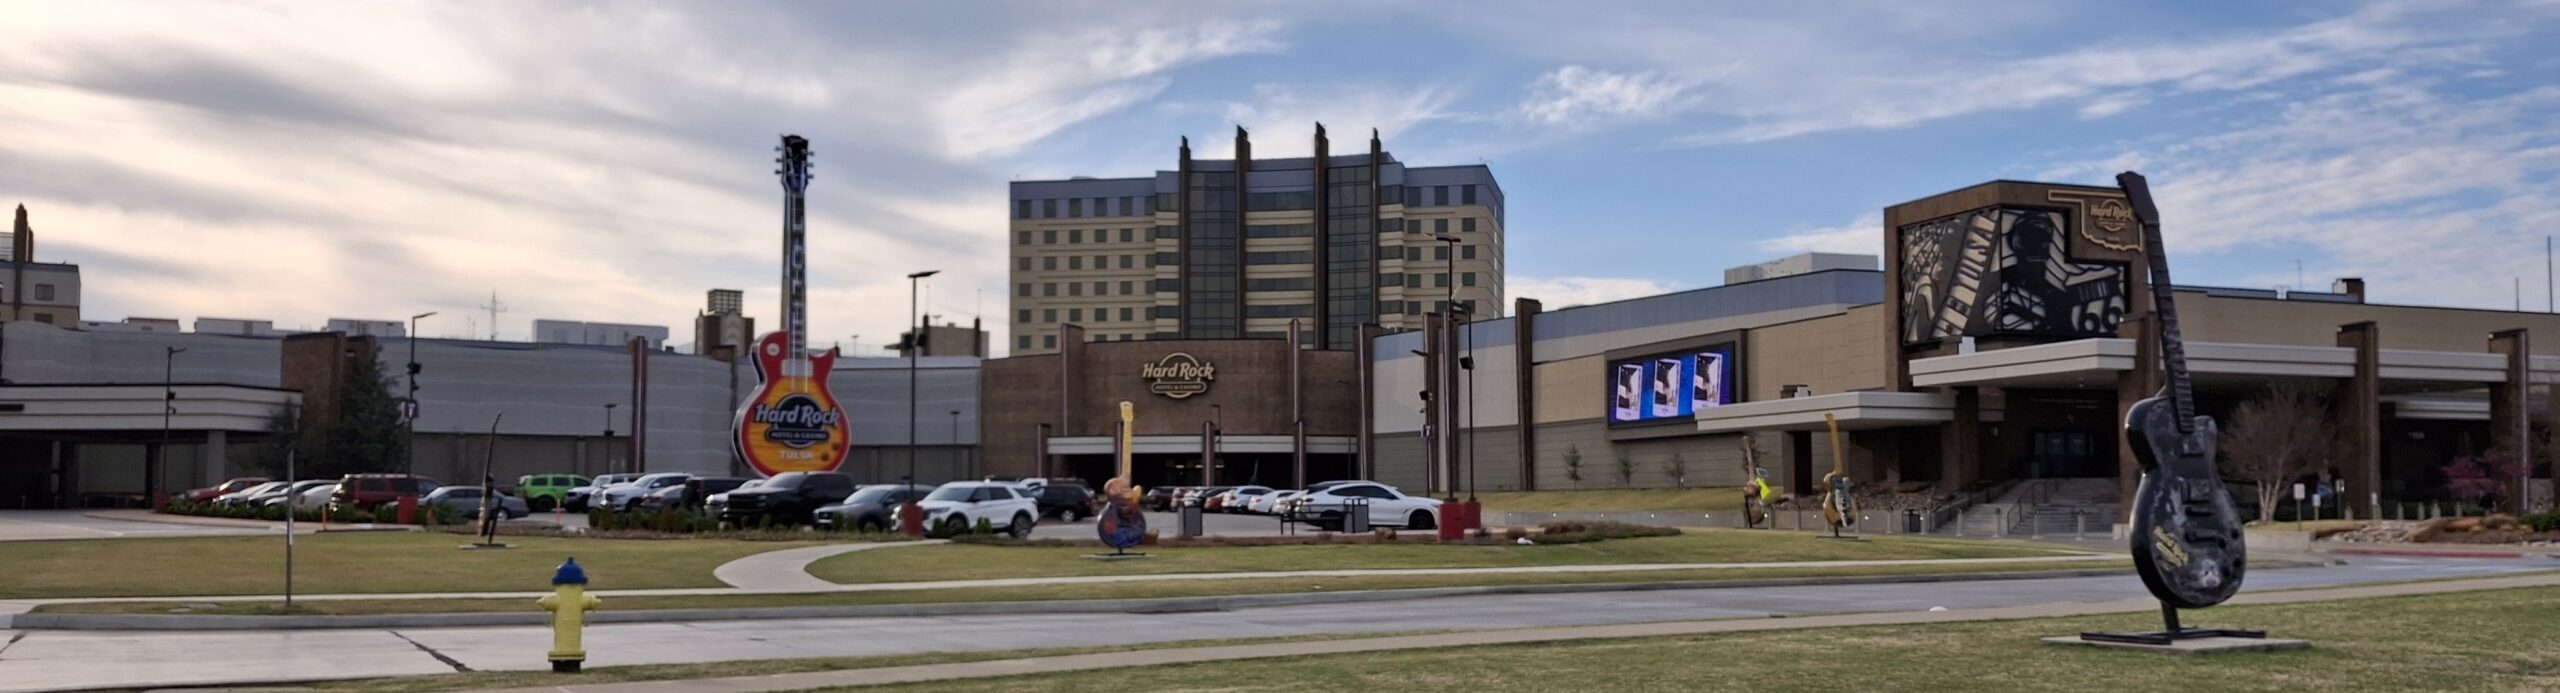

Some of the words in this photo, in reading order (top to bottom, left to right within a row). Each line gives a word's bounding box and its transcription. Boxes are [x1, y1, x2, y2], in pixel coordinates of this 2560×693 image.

[1142, 362, 1179, 378] Hard
[1179, 362, 1214, 380] Rock
[755, 404, 800, 423] Hard
[801, 404, 839, 427] Rock
